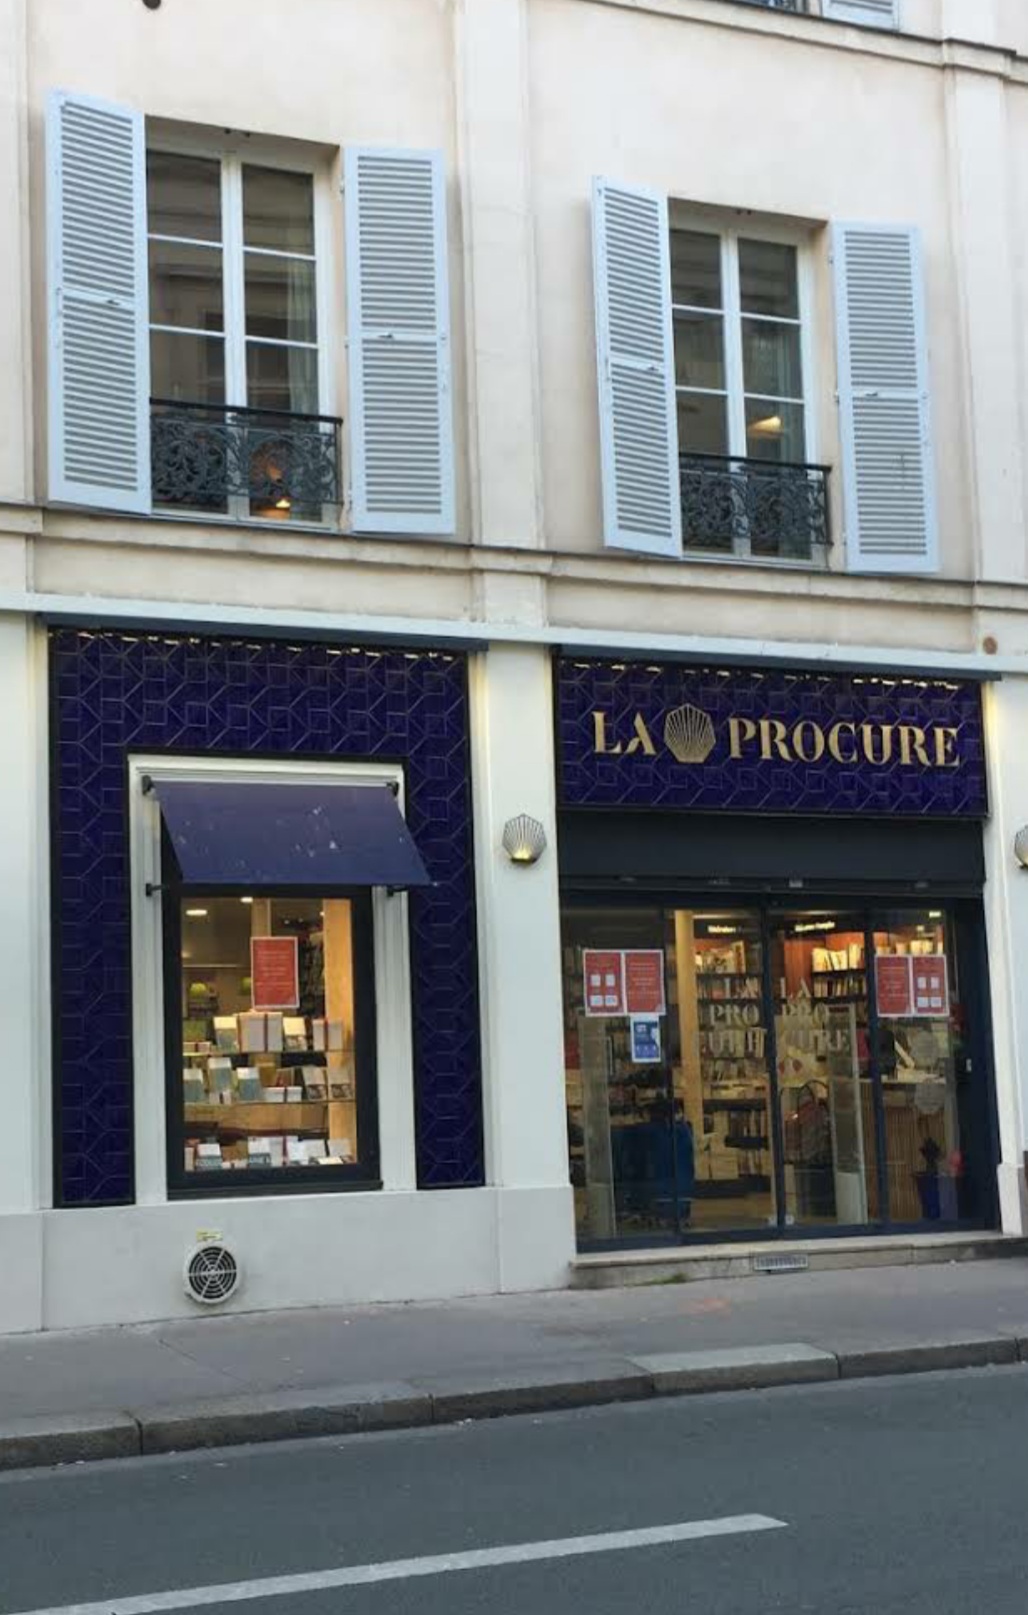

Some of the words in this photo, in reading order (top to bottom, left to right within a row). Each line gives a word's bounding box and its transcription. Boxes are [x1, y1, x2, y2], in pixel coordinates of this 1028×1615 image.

[592, 711, 657, 756] LA
[728, 717, 961, 768] PROCURE
[708, 1003, 760, 1027] PRO
